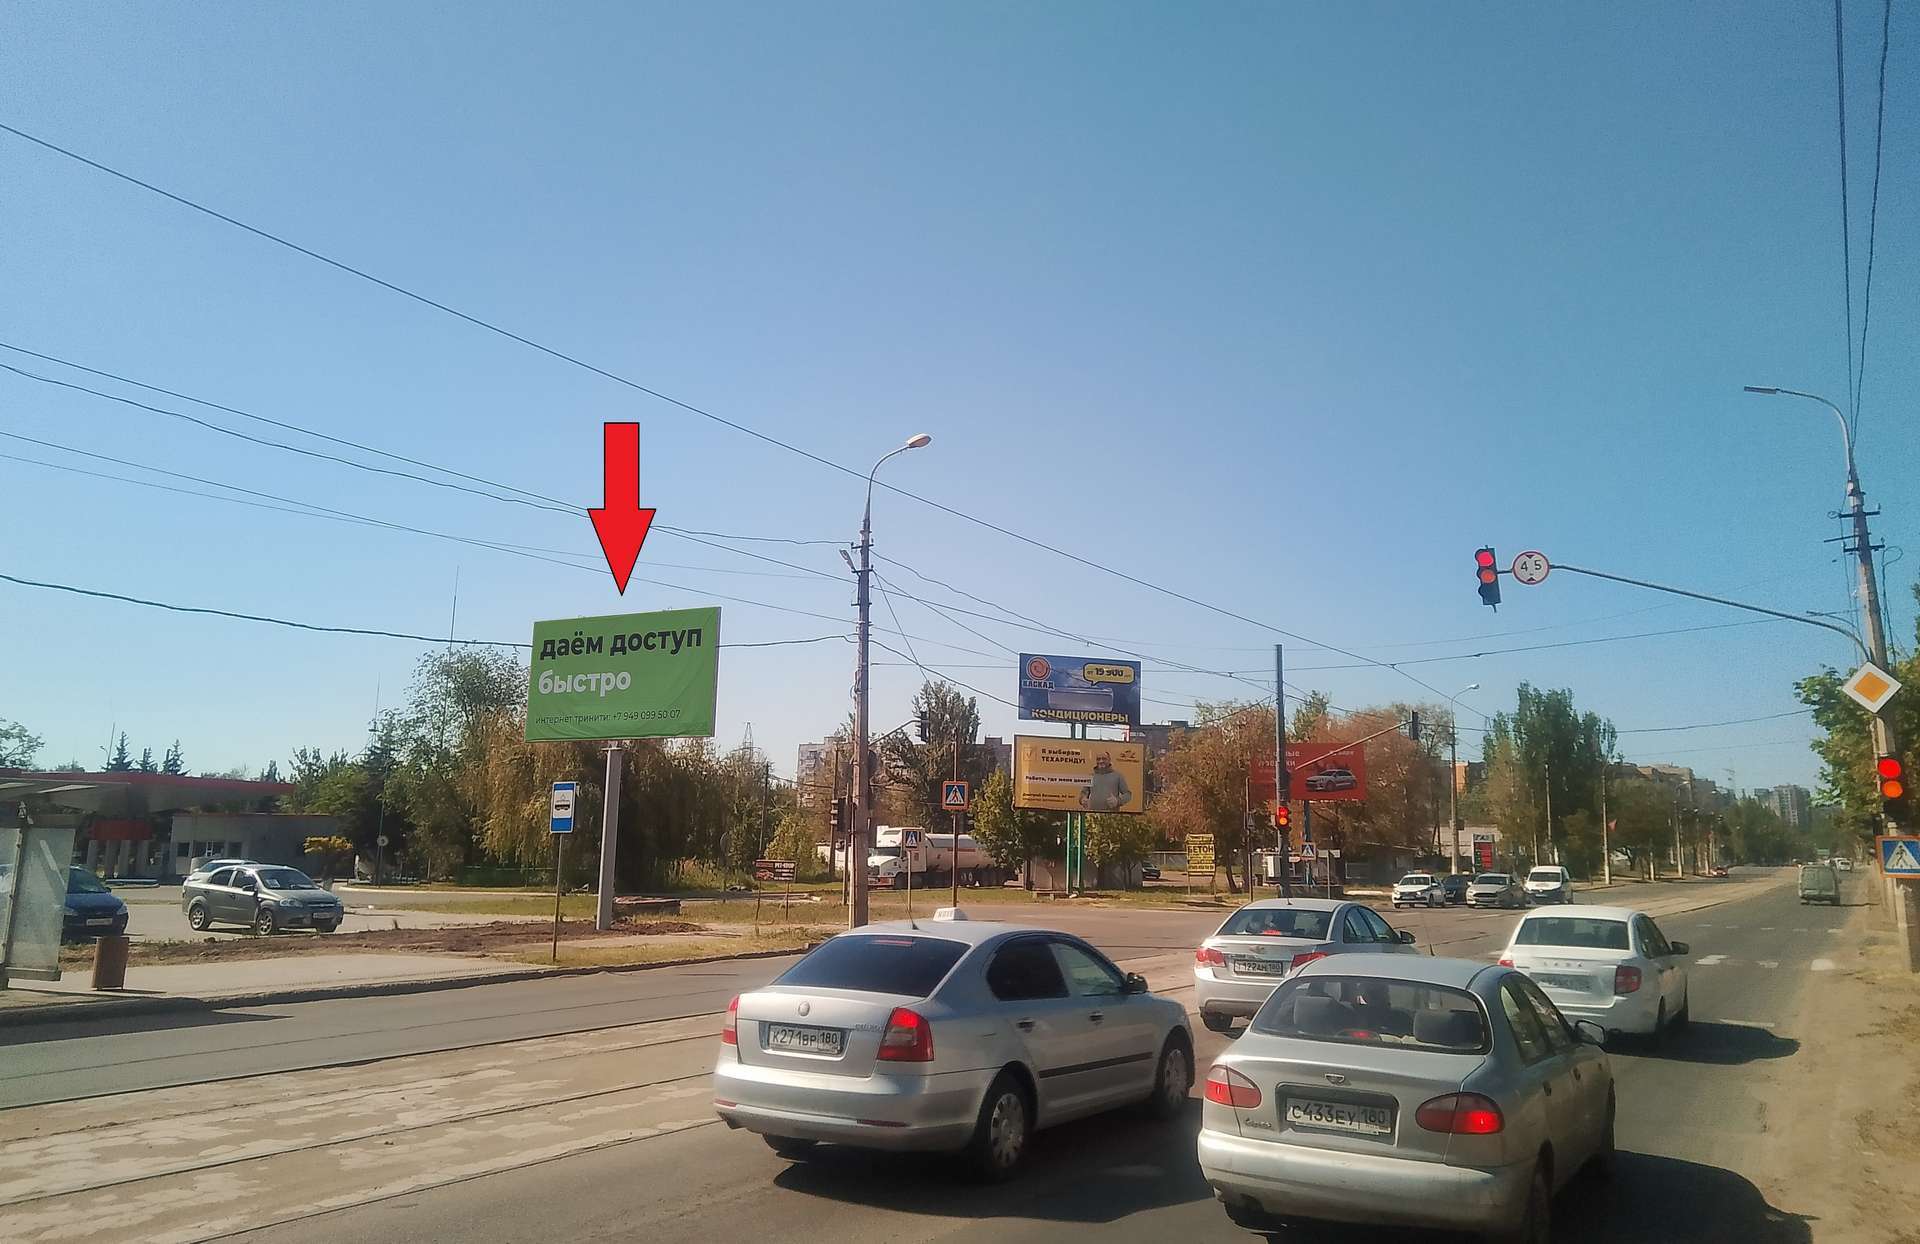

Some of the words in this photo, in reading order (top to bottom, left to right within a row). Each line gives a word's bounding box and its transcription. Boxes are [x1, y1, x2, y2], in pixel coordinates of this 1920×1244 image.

[540, 631, 604, 660] даём
[609, 628, 702, 656] доступ
[538, 670, 632, 697] быстро
[535, 715, 573, 726] интернет
[575, 713, 611, 725] тринити:
[613, 712, 622, 721] +7
[624, 711, 639, 721] 949
[670, 709, 681, 719] 07
[1031, 708, 1129, 722] КОНДИЦИОНЕРЫ
[1188, 845, 1213, 855] БЕТОН
[772, 1028, 817, 1046] К271ВР
[819, 1031, 838, 1045] 180
[1291, 1103, 1356, 1126] С433ЕУ
[1360, 1108, 1386, 1124] 180
